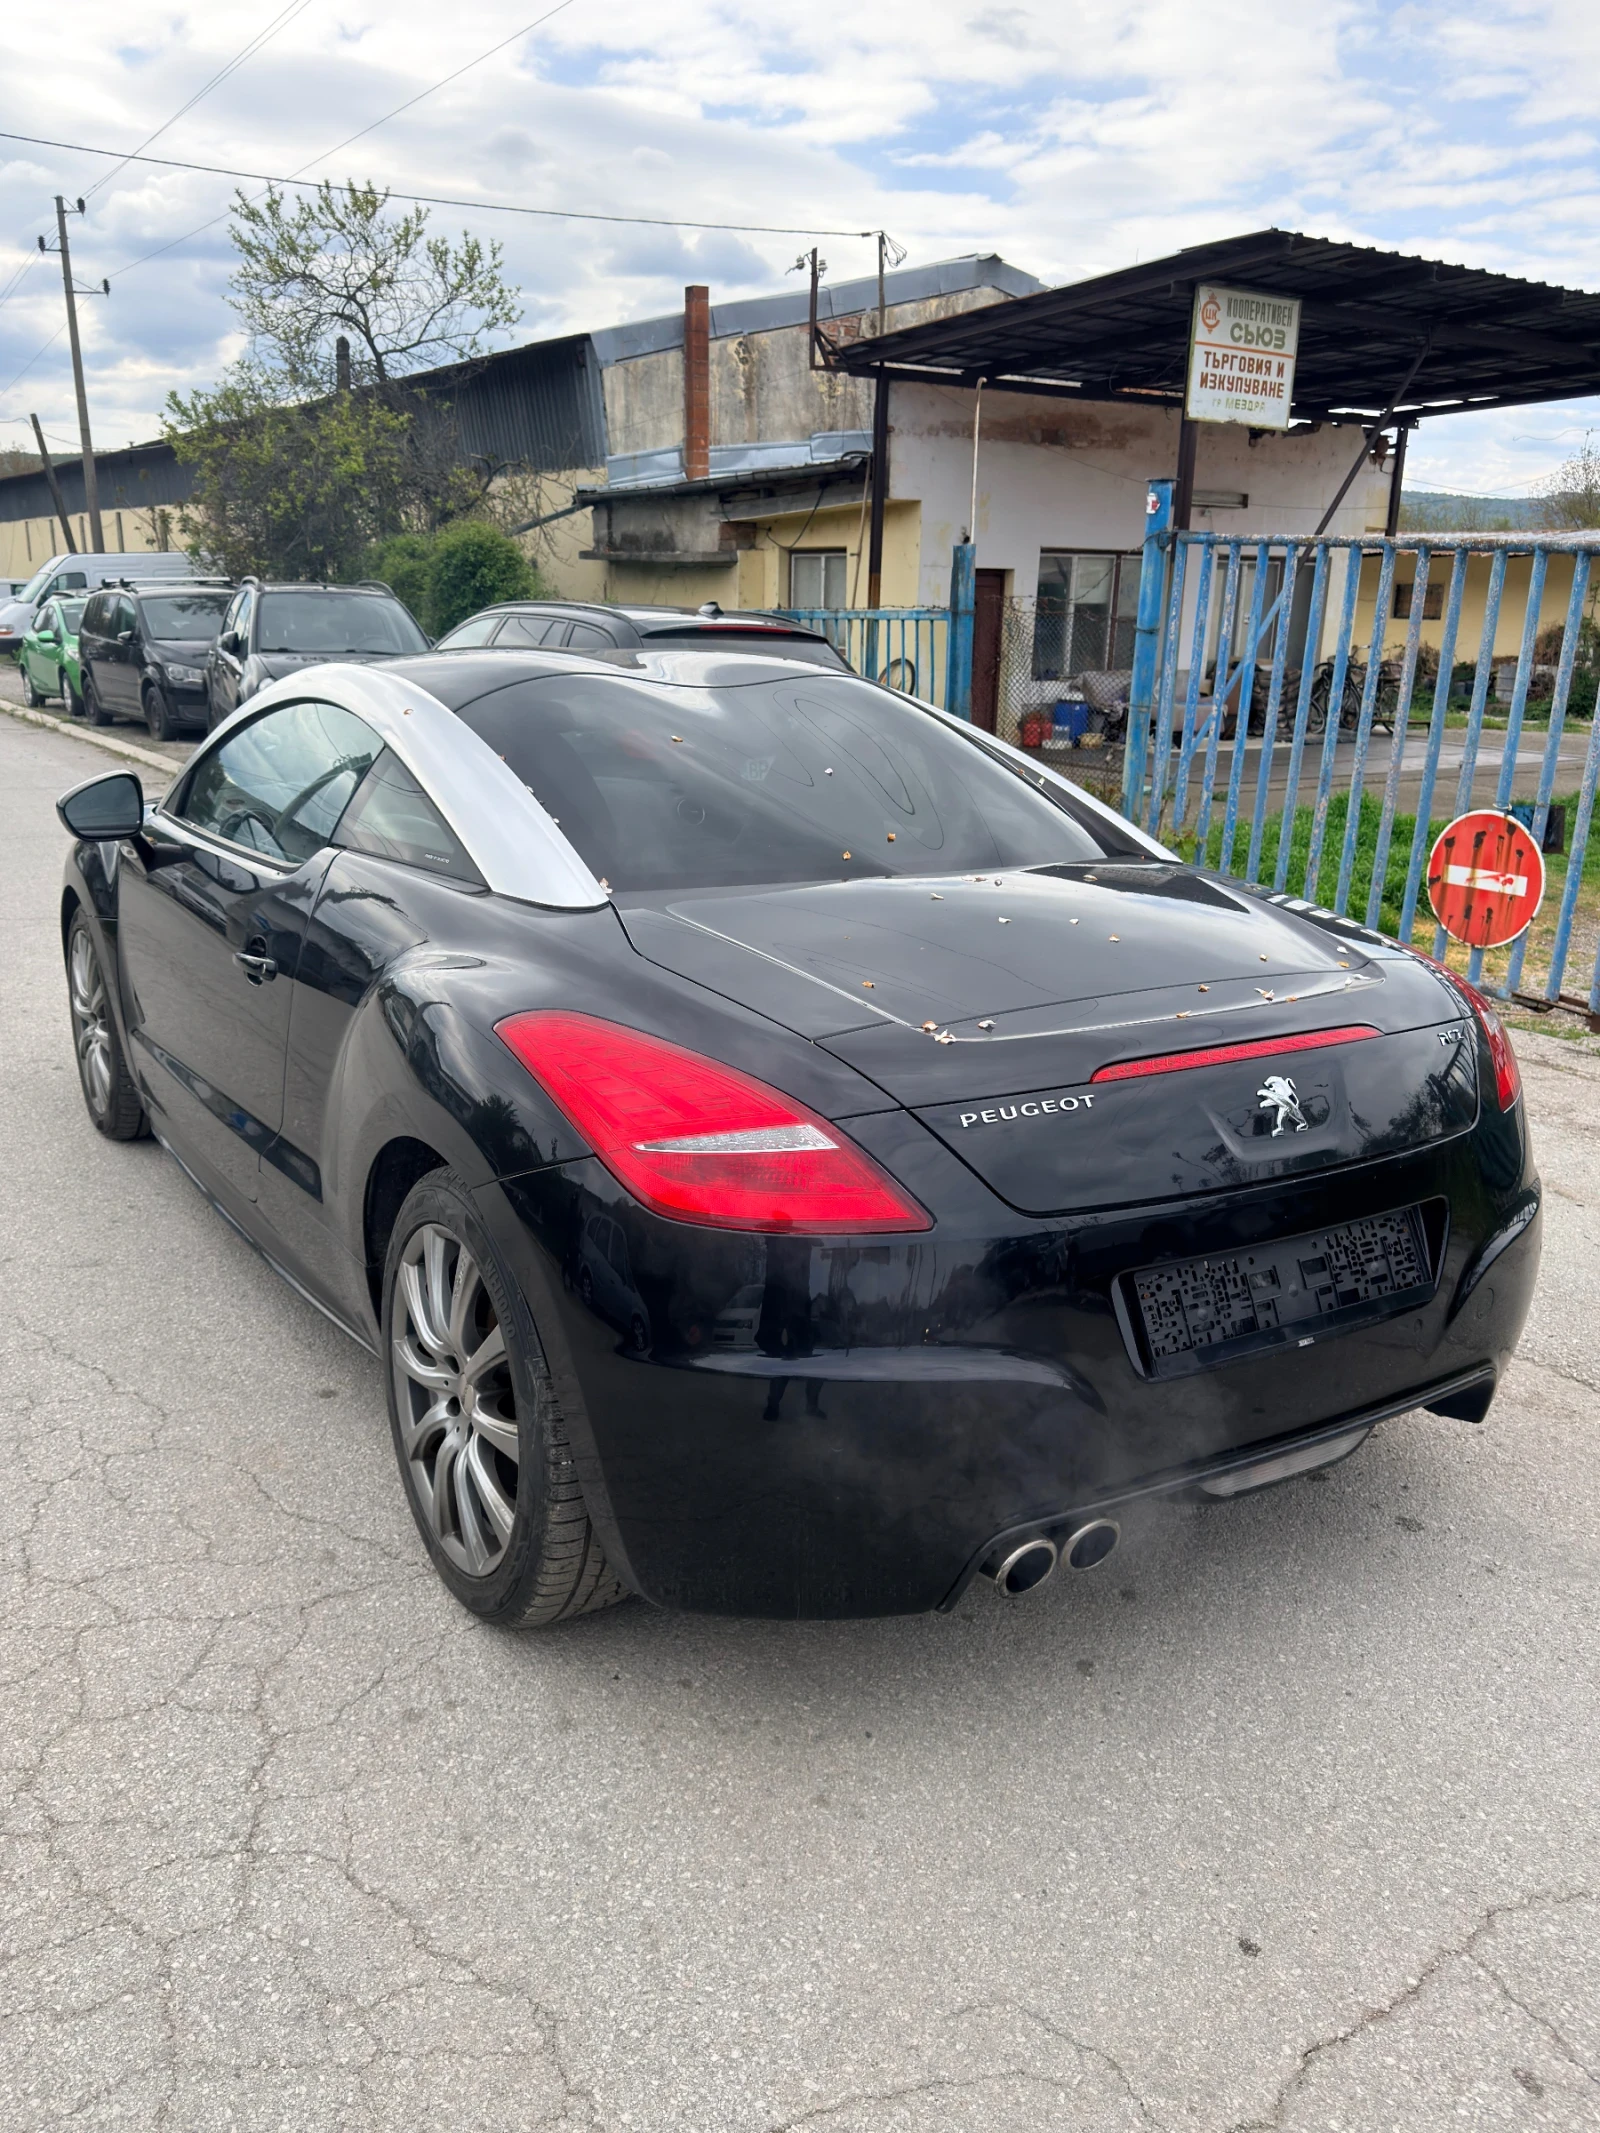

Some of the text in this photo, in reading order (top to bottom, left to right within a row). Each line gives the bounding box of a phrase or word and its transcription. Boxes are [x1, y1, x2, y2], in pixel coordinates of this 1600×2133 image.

[1227, 297, 1293, 327] КООПЕРАТИВЕН
[1277, 361, 1285, 378] И
[1200, 372, 1285, 399] ИЗКУПУВАНЕ
[959, 1094, 1095, 1128] PEUGEOT
